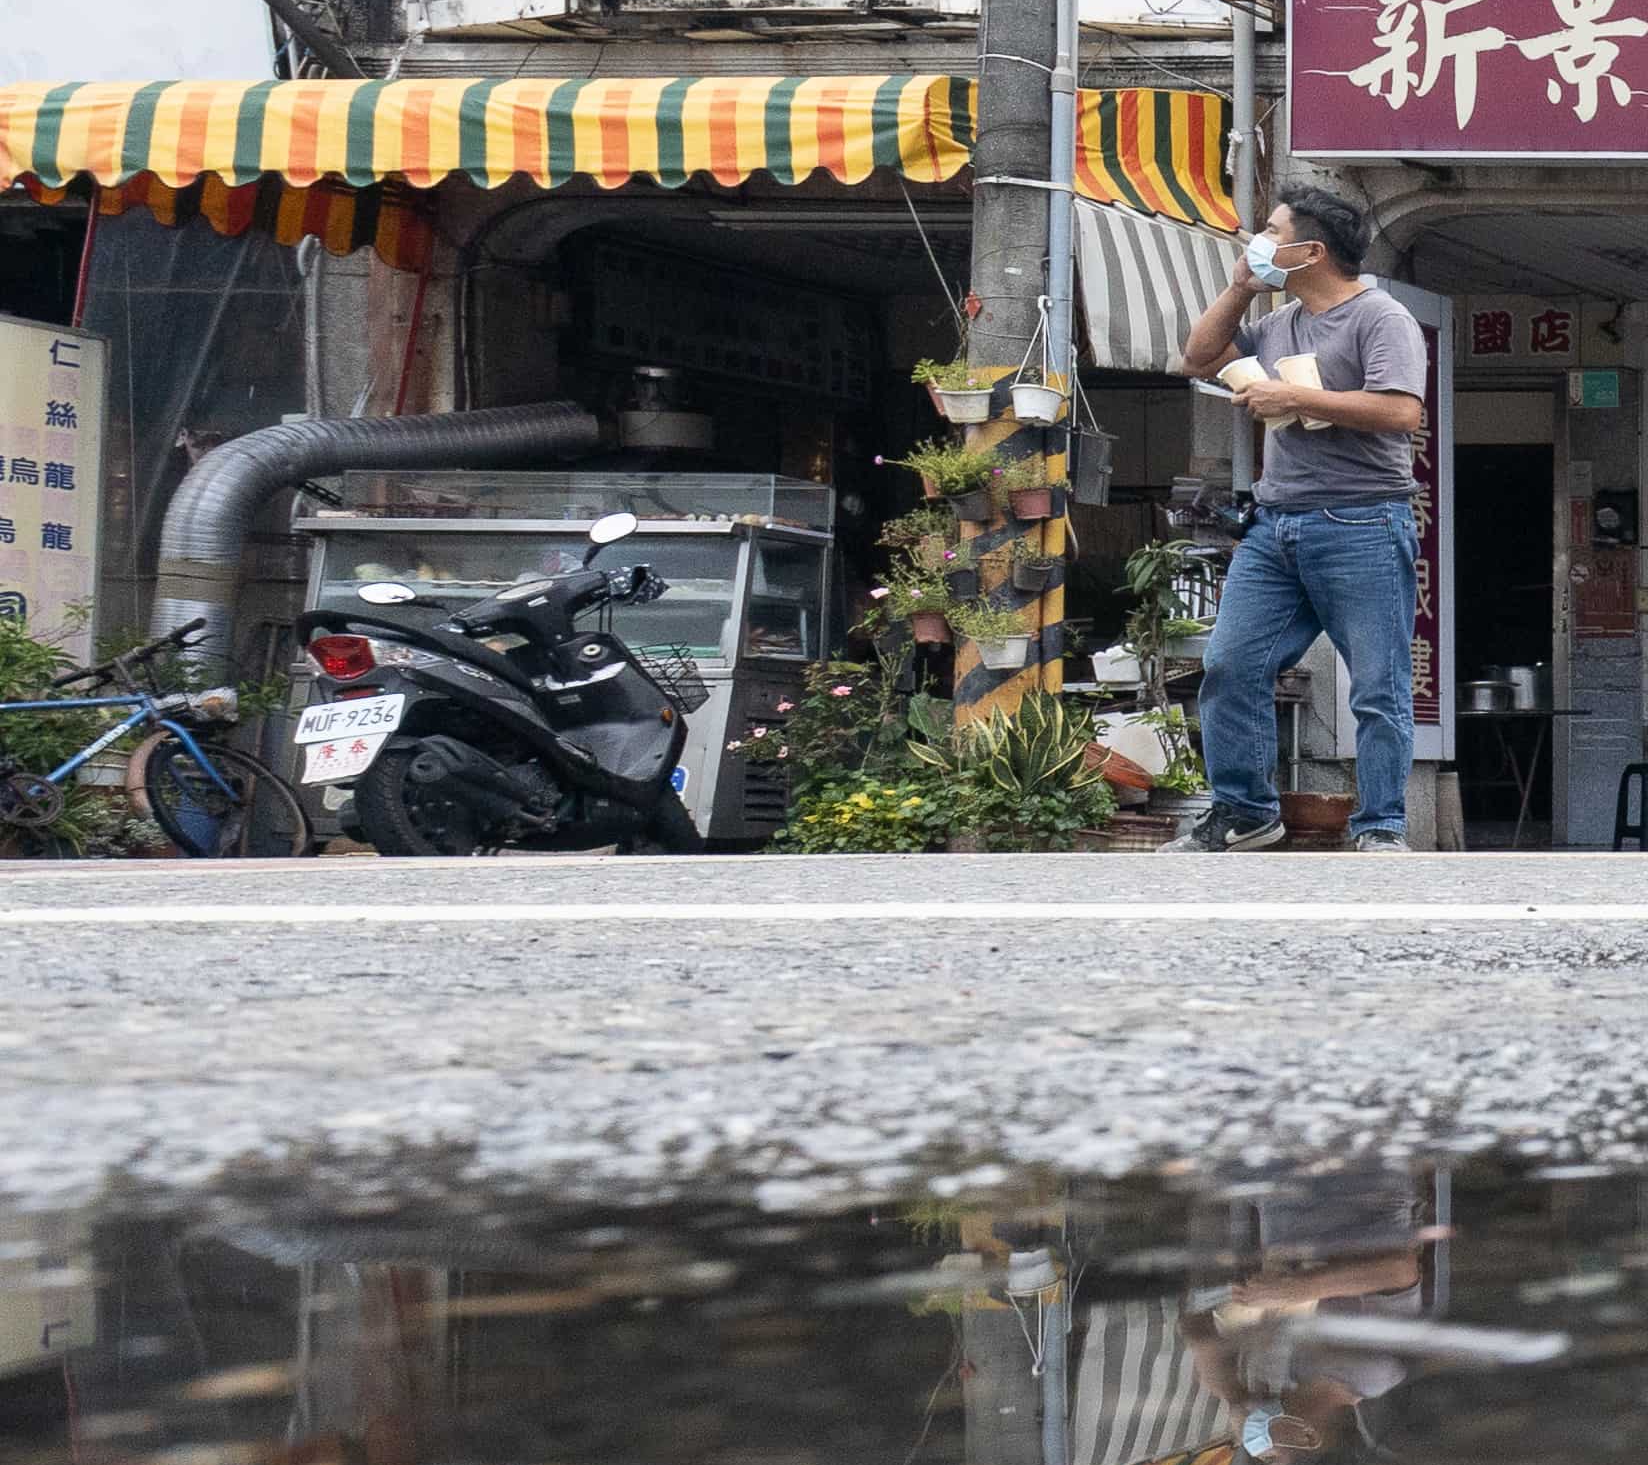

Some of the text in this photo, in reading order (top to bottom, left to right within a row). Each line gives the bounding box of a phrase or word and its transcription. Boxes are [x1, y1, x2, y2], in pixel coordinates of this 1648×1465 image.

[1453, 309, 1572, 355] 盟店
[0, 454, 77, 492] 烏龍
[301, 703, 398, 734] MUF-9236
